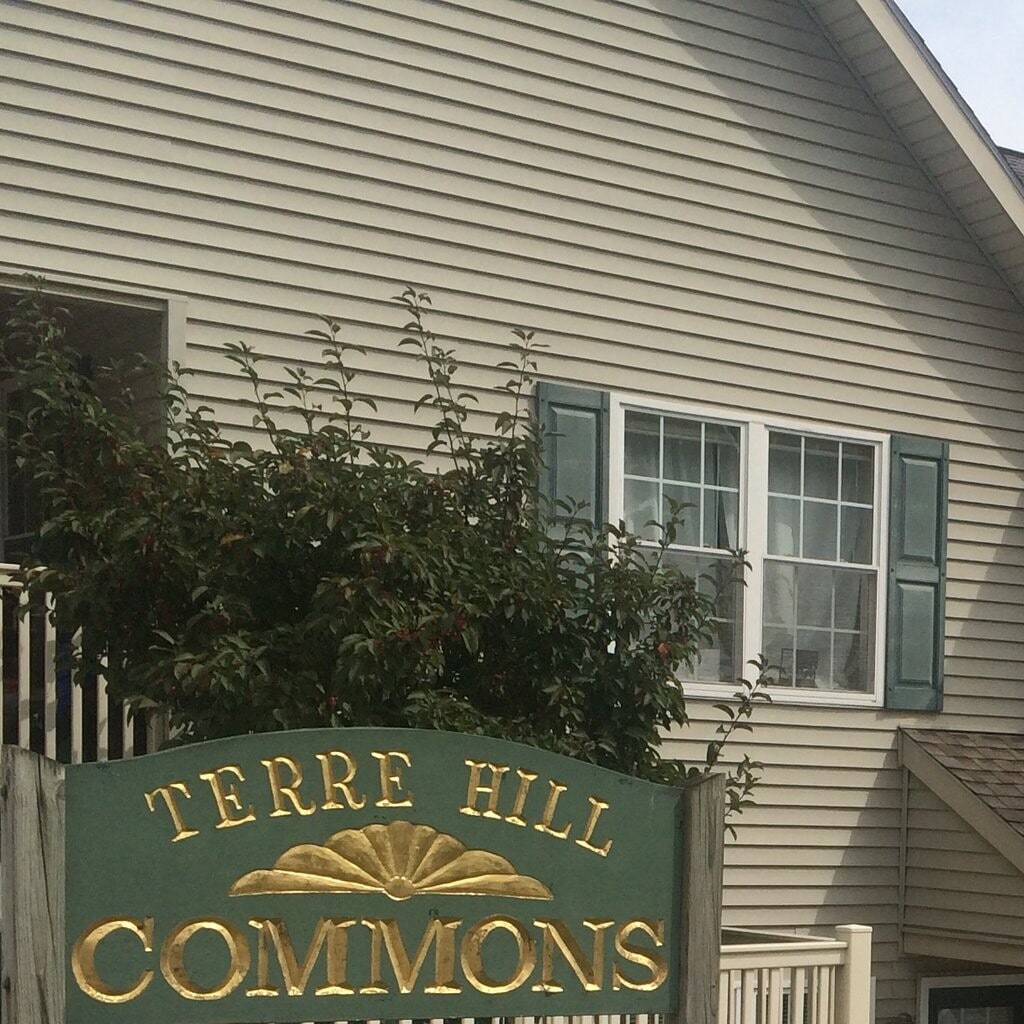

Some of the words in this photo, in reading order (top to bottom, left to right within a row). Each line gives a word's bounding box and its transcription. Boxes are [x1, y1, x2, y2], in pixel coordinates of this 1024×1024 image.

[145, 750, 414, 843] TERRE
[459, 759, 613, 857] HILL
[71, 915, 669, 1004] COMMONS
